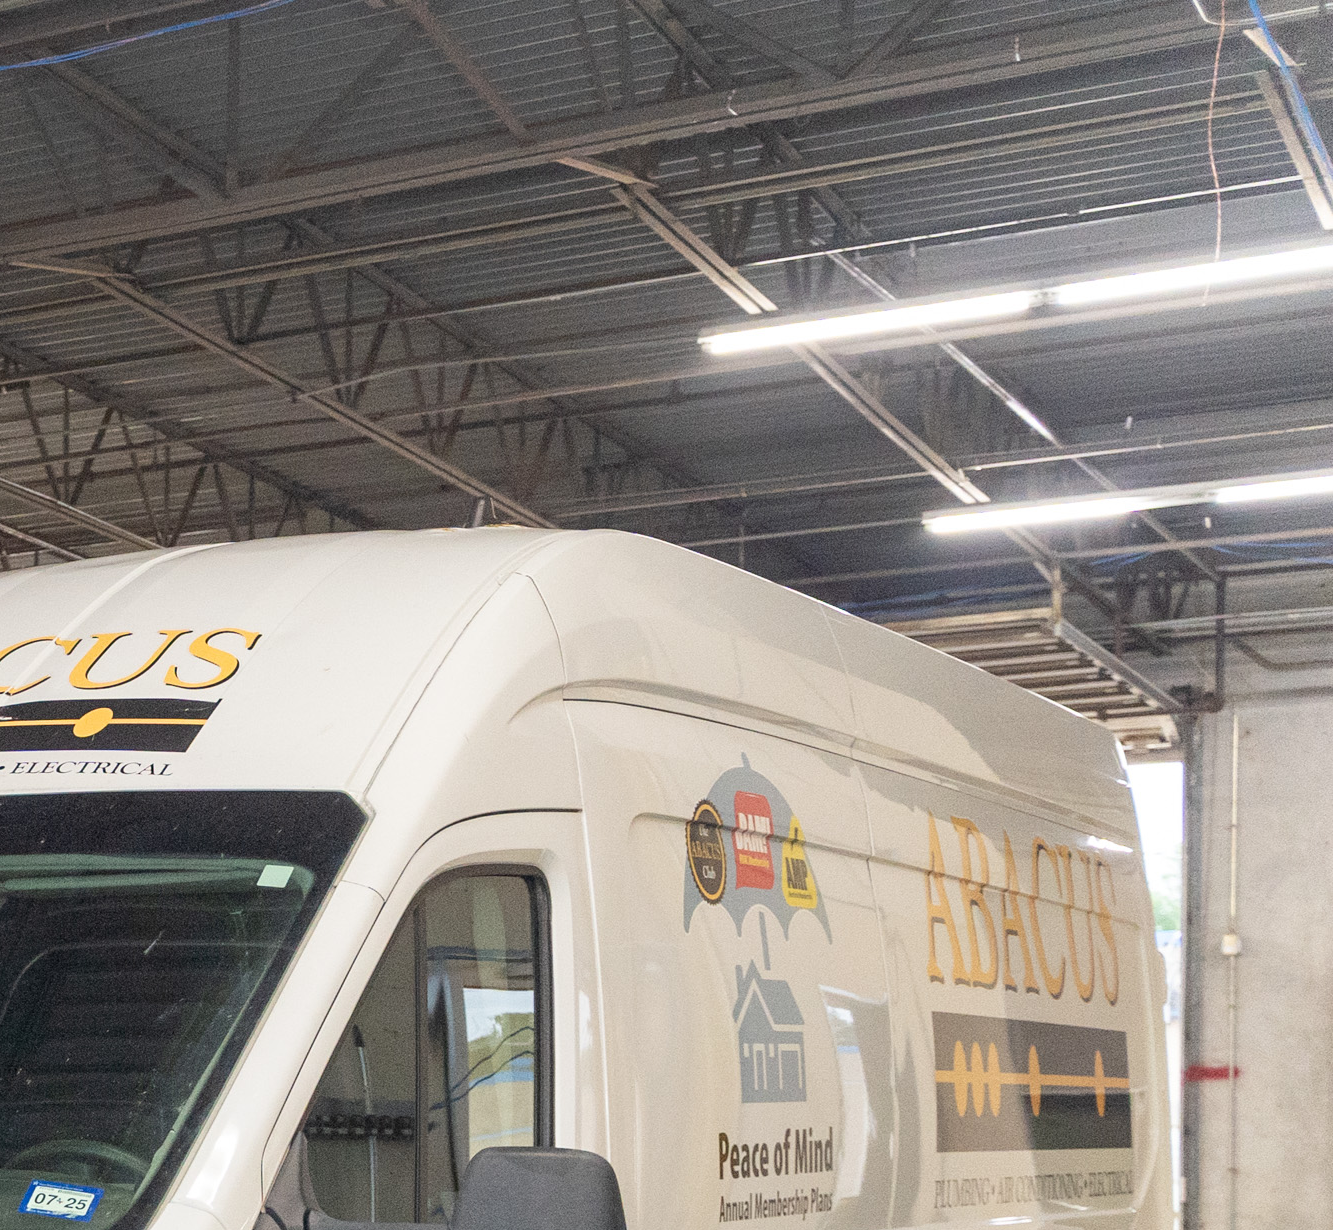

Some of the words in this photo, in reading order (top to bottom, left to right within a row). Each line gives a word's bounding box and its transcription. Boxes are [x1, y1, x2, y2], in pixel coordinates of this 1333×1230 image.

[9, 760, 174, 777] ELECTRICAL
[924, 810, 1120, 1006] ABACUS
[719, 1132, 769, 1180] Peace
[774, 1128, 791, 1176] of
[795, 1126, 833, 1174] Mind
[34, 1193, 58, 1205] 07
[64, 1198, 88, 1210] 25
[719, 1193, 752, 1222] Annual
[754, 1189, 809, 1221] Membership
[811, 1187, 833, 1213] Plans
